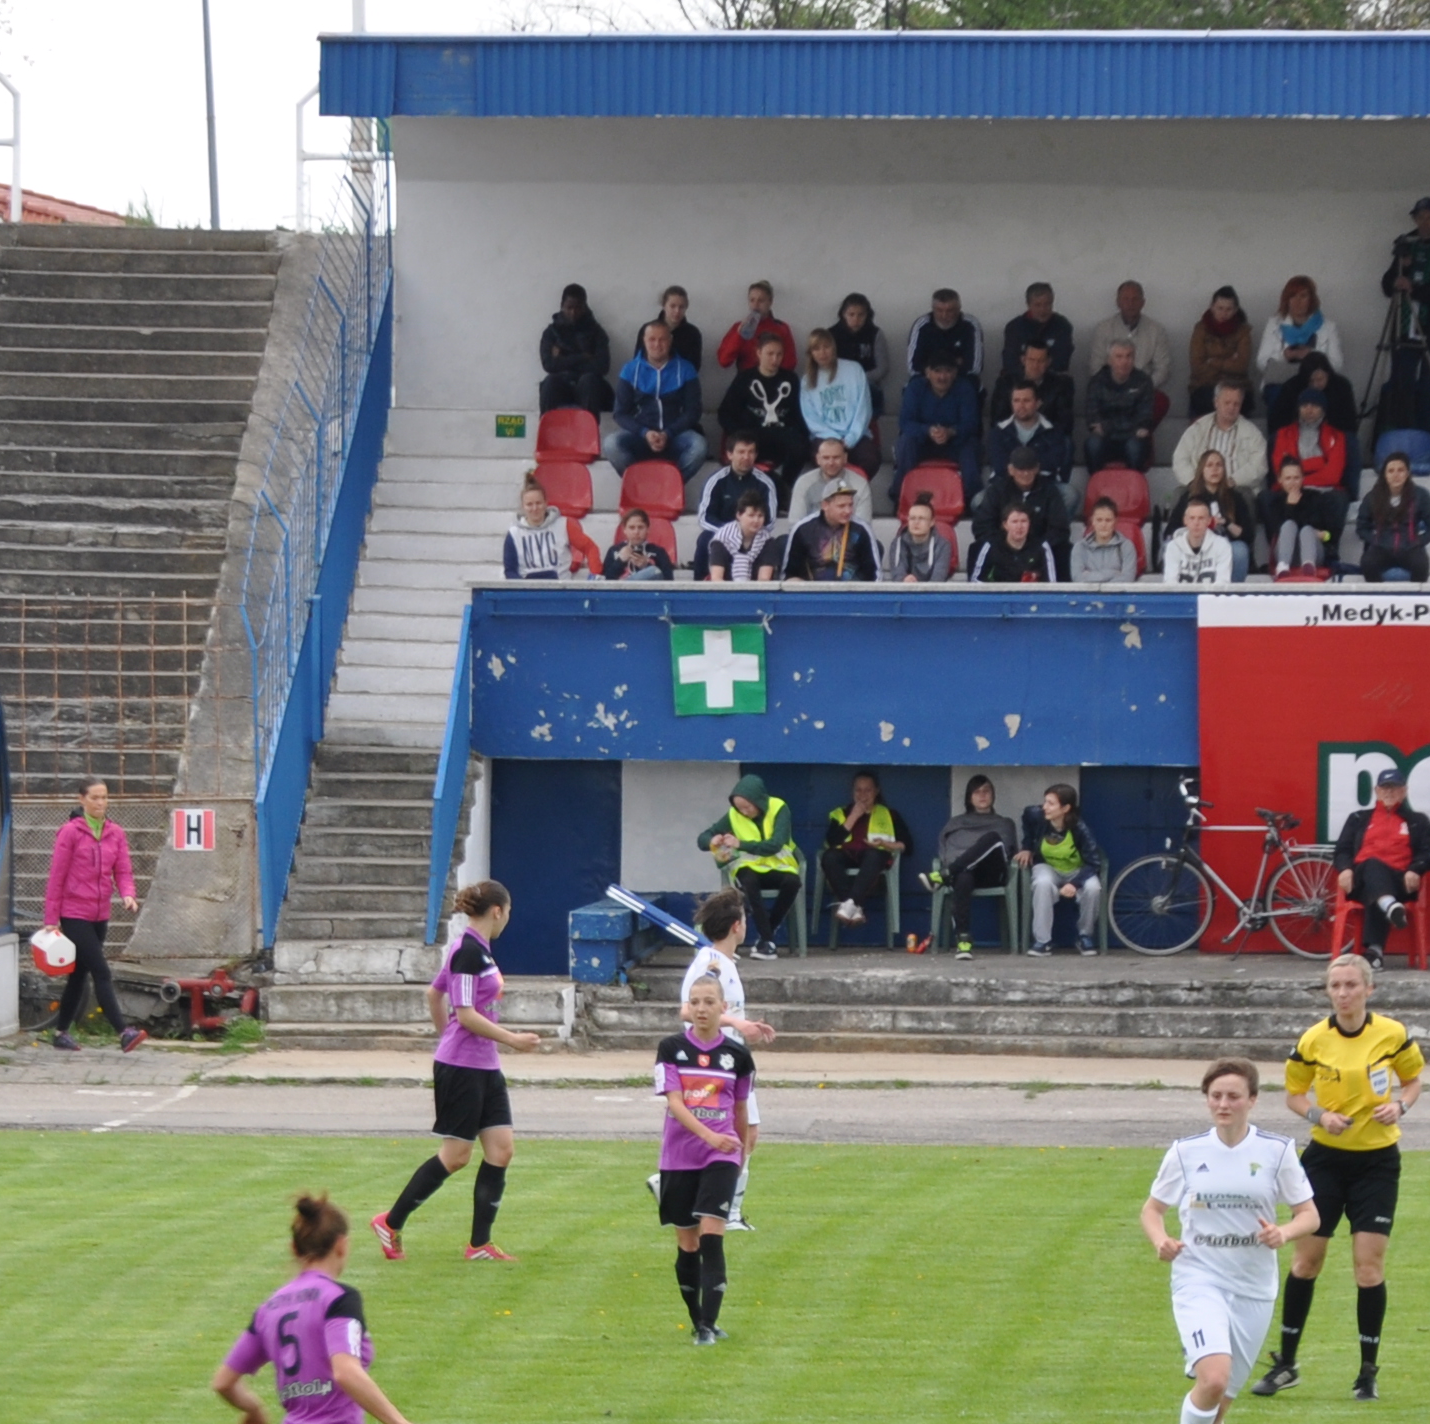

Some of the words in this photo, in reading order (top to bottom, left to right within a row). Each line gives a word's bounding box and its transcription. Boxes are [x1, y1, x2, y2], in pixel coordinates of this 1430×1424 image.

[187, 814, 202, 845] H
[277, 1310, 301, 1376] 5
[1192, 1329, 1206, 1349] 11
